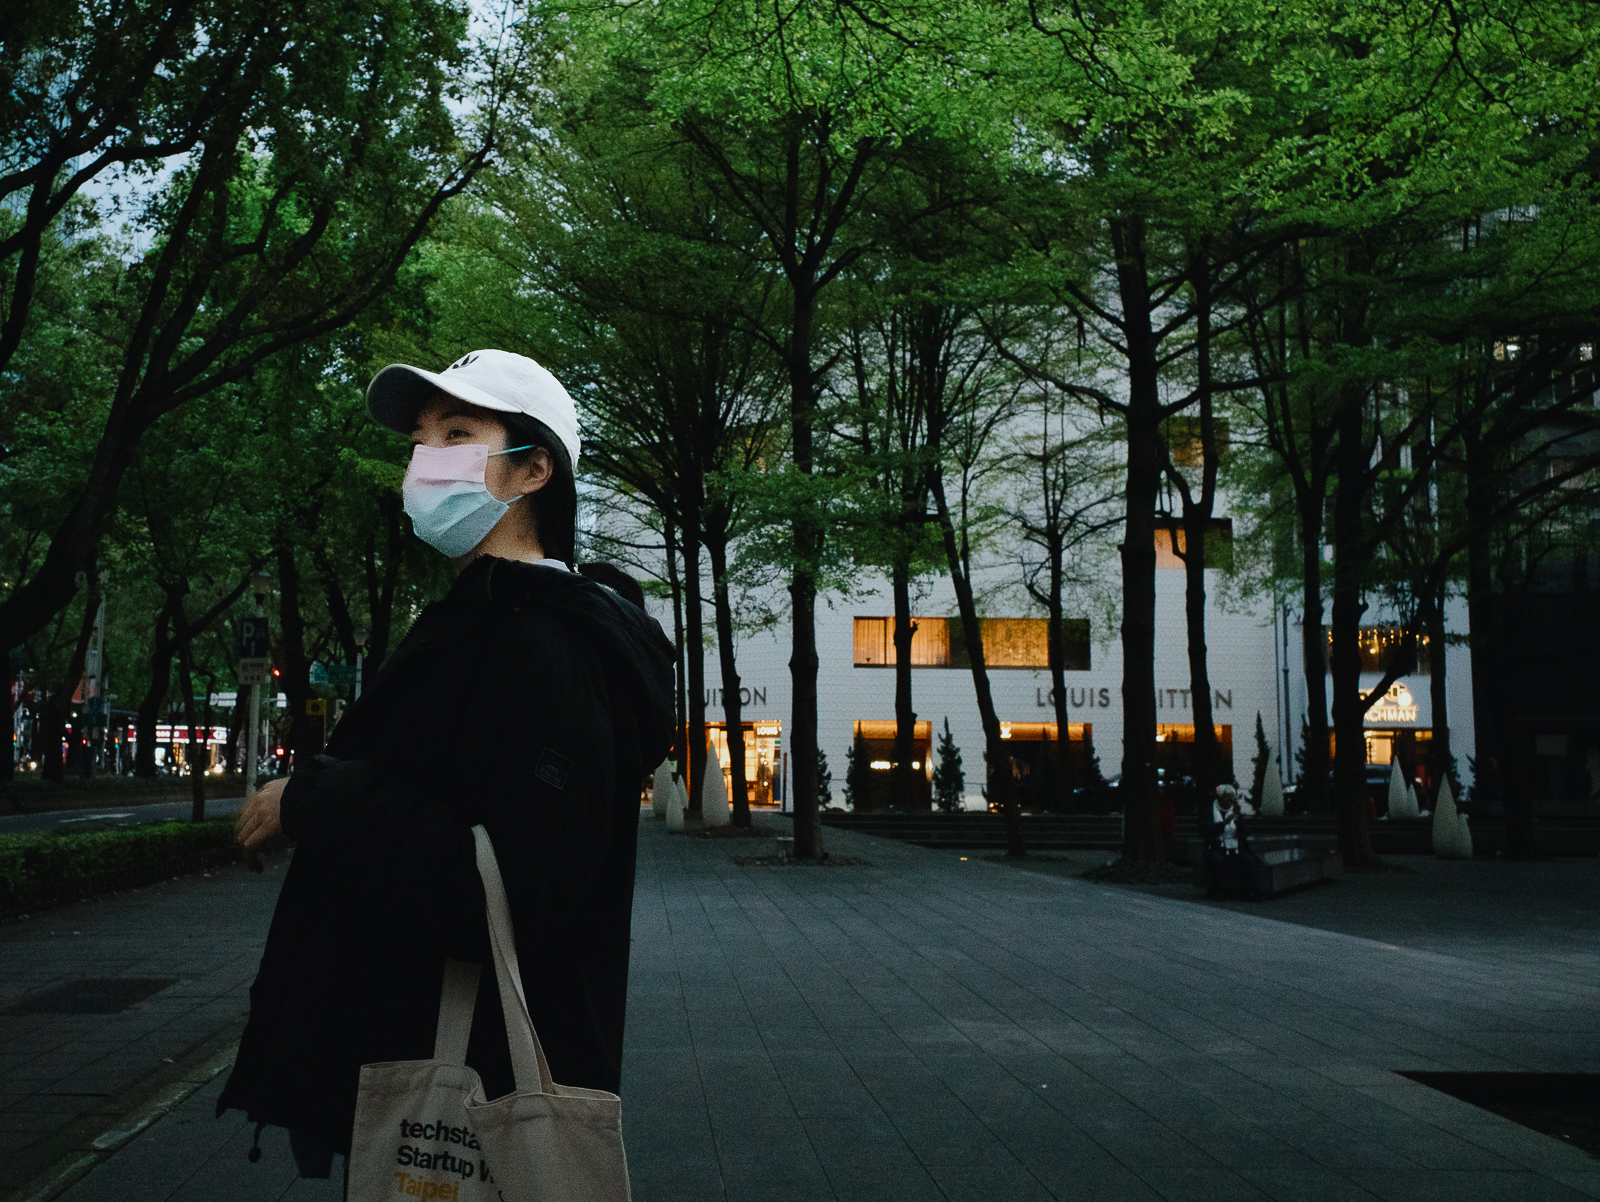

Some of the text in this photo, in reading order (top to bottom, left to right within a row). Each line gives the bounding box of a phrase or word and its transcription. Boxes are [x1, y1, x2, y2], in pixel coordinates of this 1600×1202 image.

[1158, 688, 1233, 709] ITTN
[400, 1119, 482, 1151] techsta
[397, 1144, 475, 1180] Startup
[394, 1172, 459, 1202] Taipei
